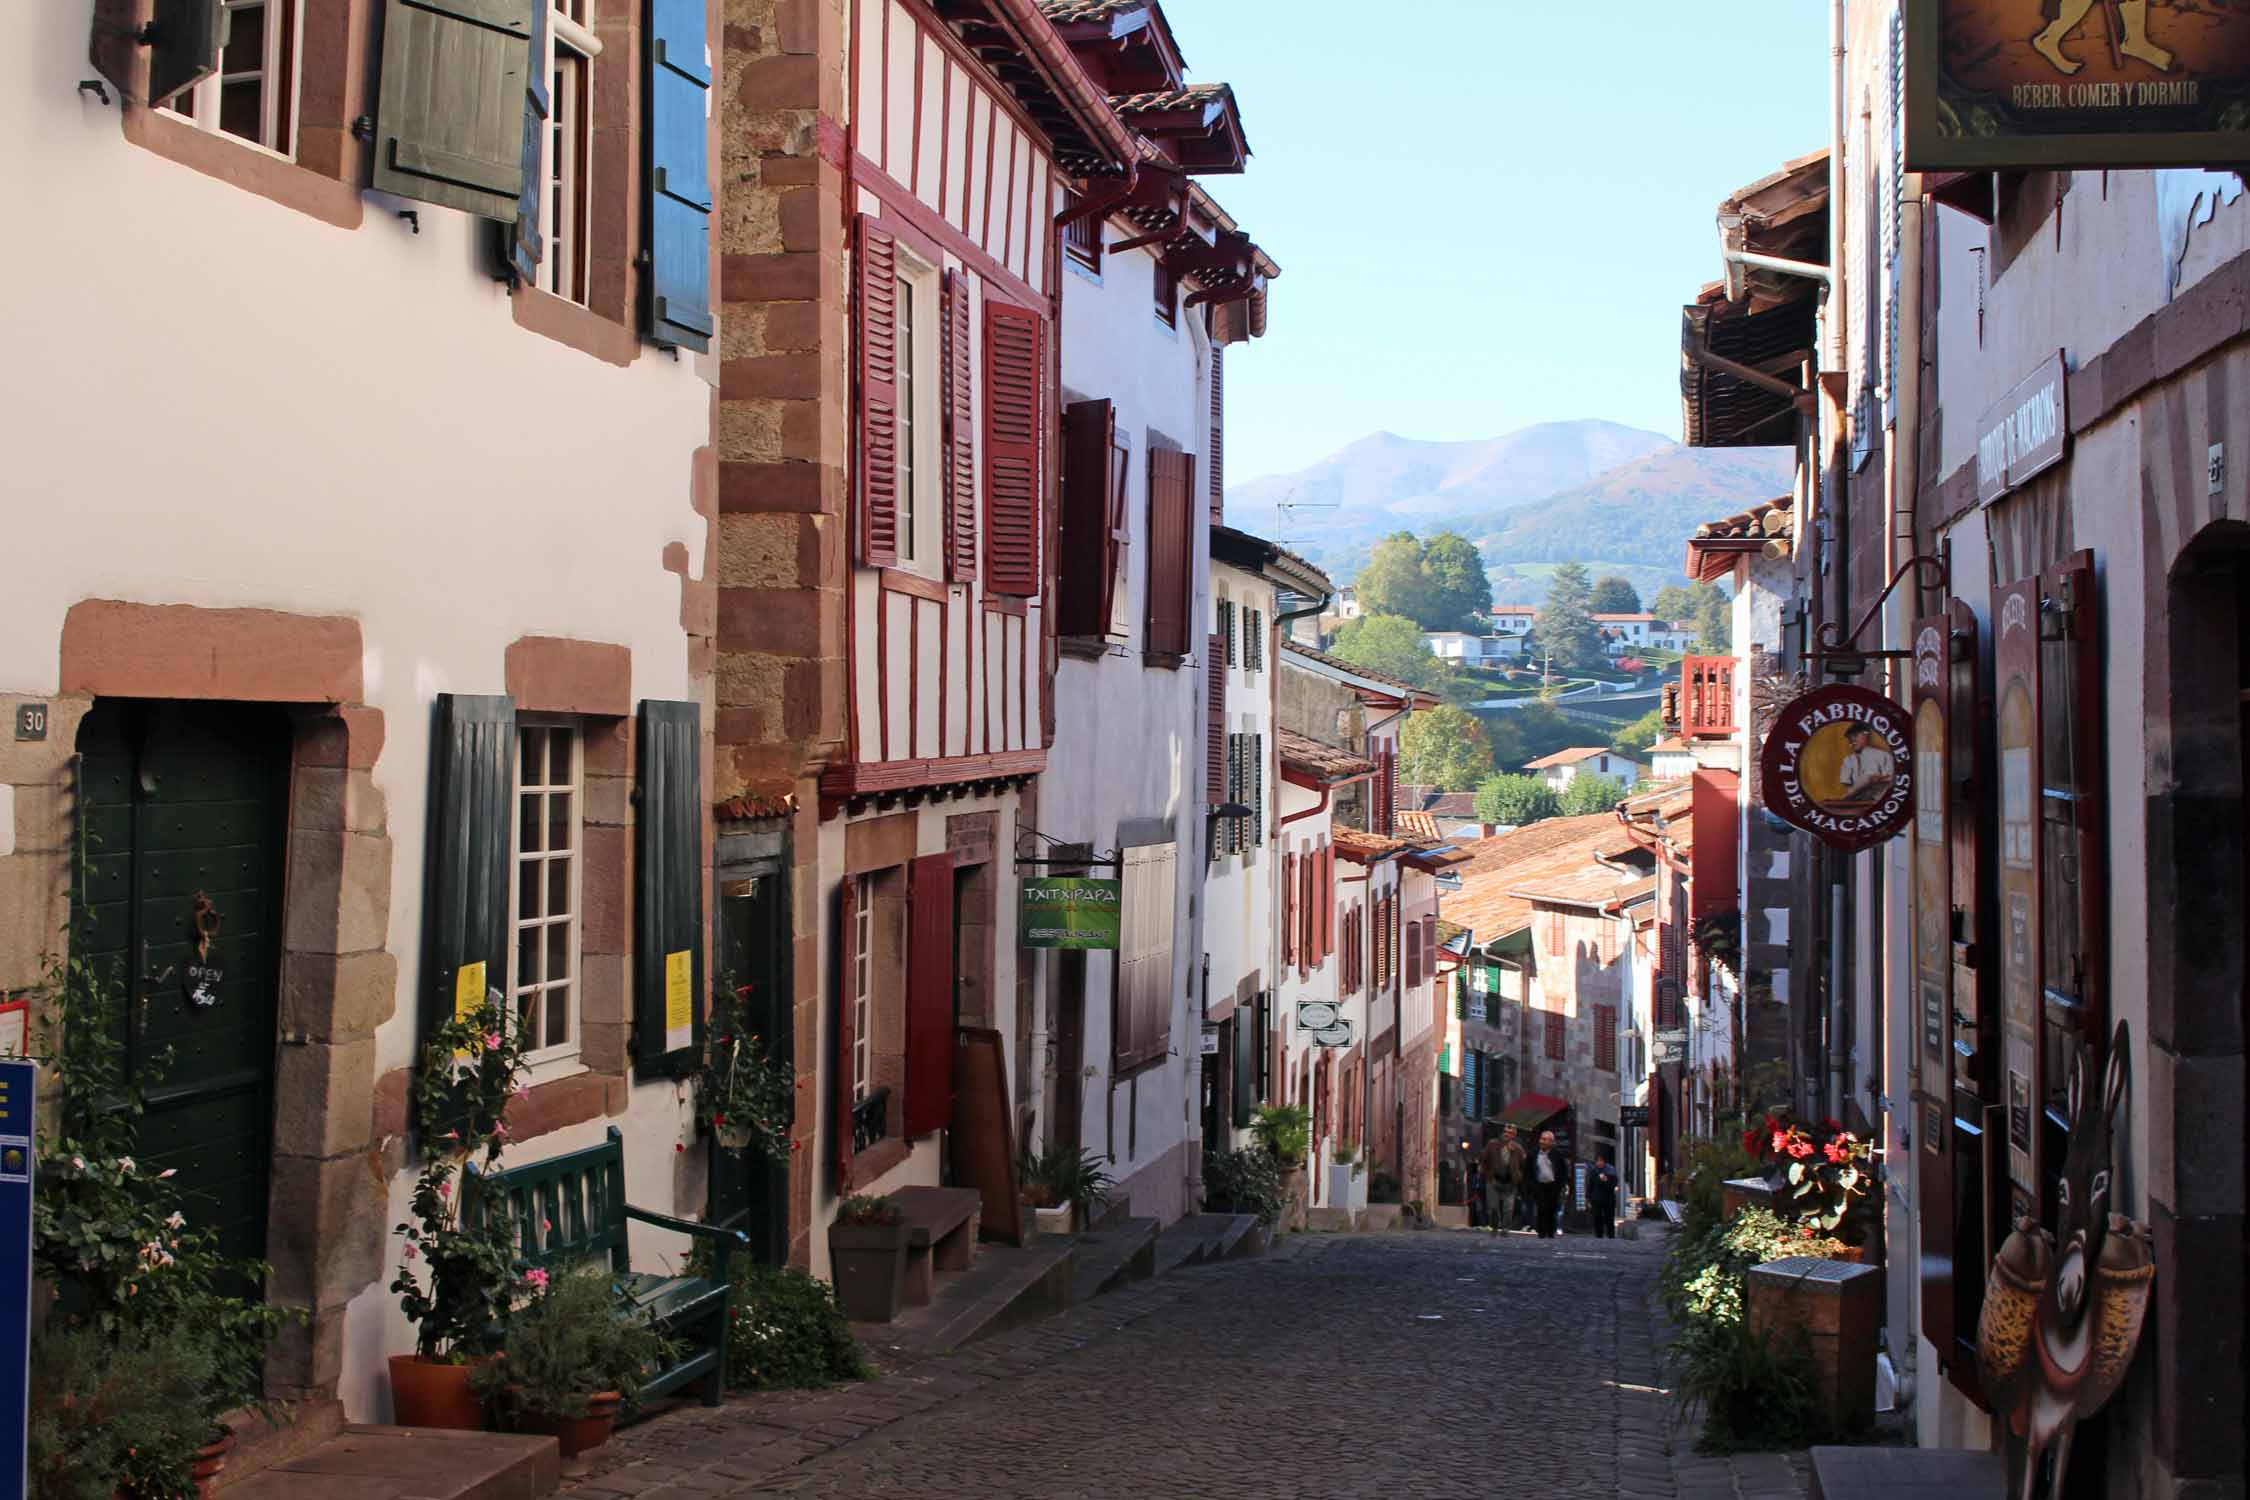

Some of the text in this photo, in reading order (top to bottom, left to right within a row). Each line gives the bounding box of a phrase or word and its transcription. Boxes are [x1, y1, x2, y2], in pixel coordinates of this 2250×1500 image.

[2068, 83, 2121, 107] COMER
[2124, 82, 2135, 105] Y
[2138, 80, 2200, 105] DORMIR
[24, 711, 44, 731] 30
[1778, 703, 1911, 772] LA FABRIQUE
[1783, 773, 1911, 832] DE MACARONS
[190, 966, 224, 982] OPEN
